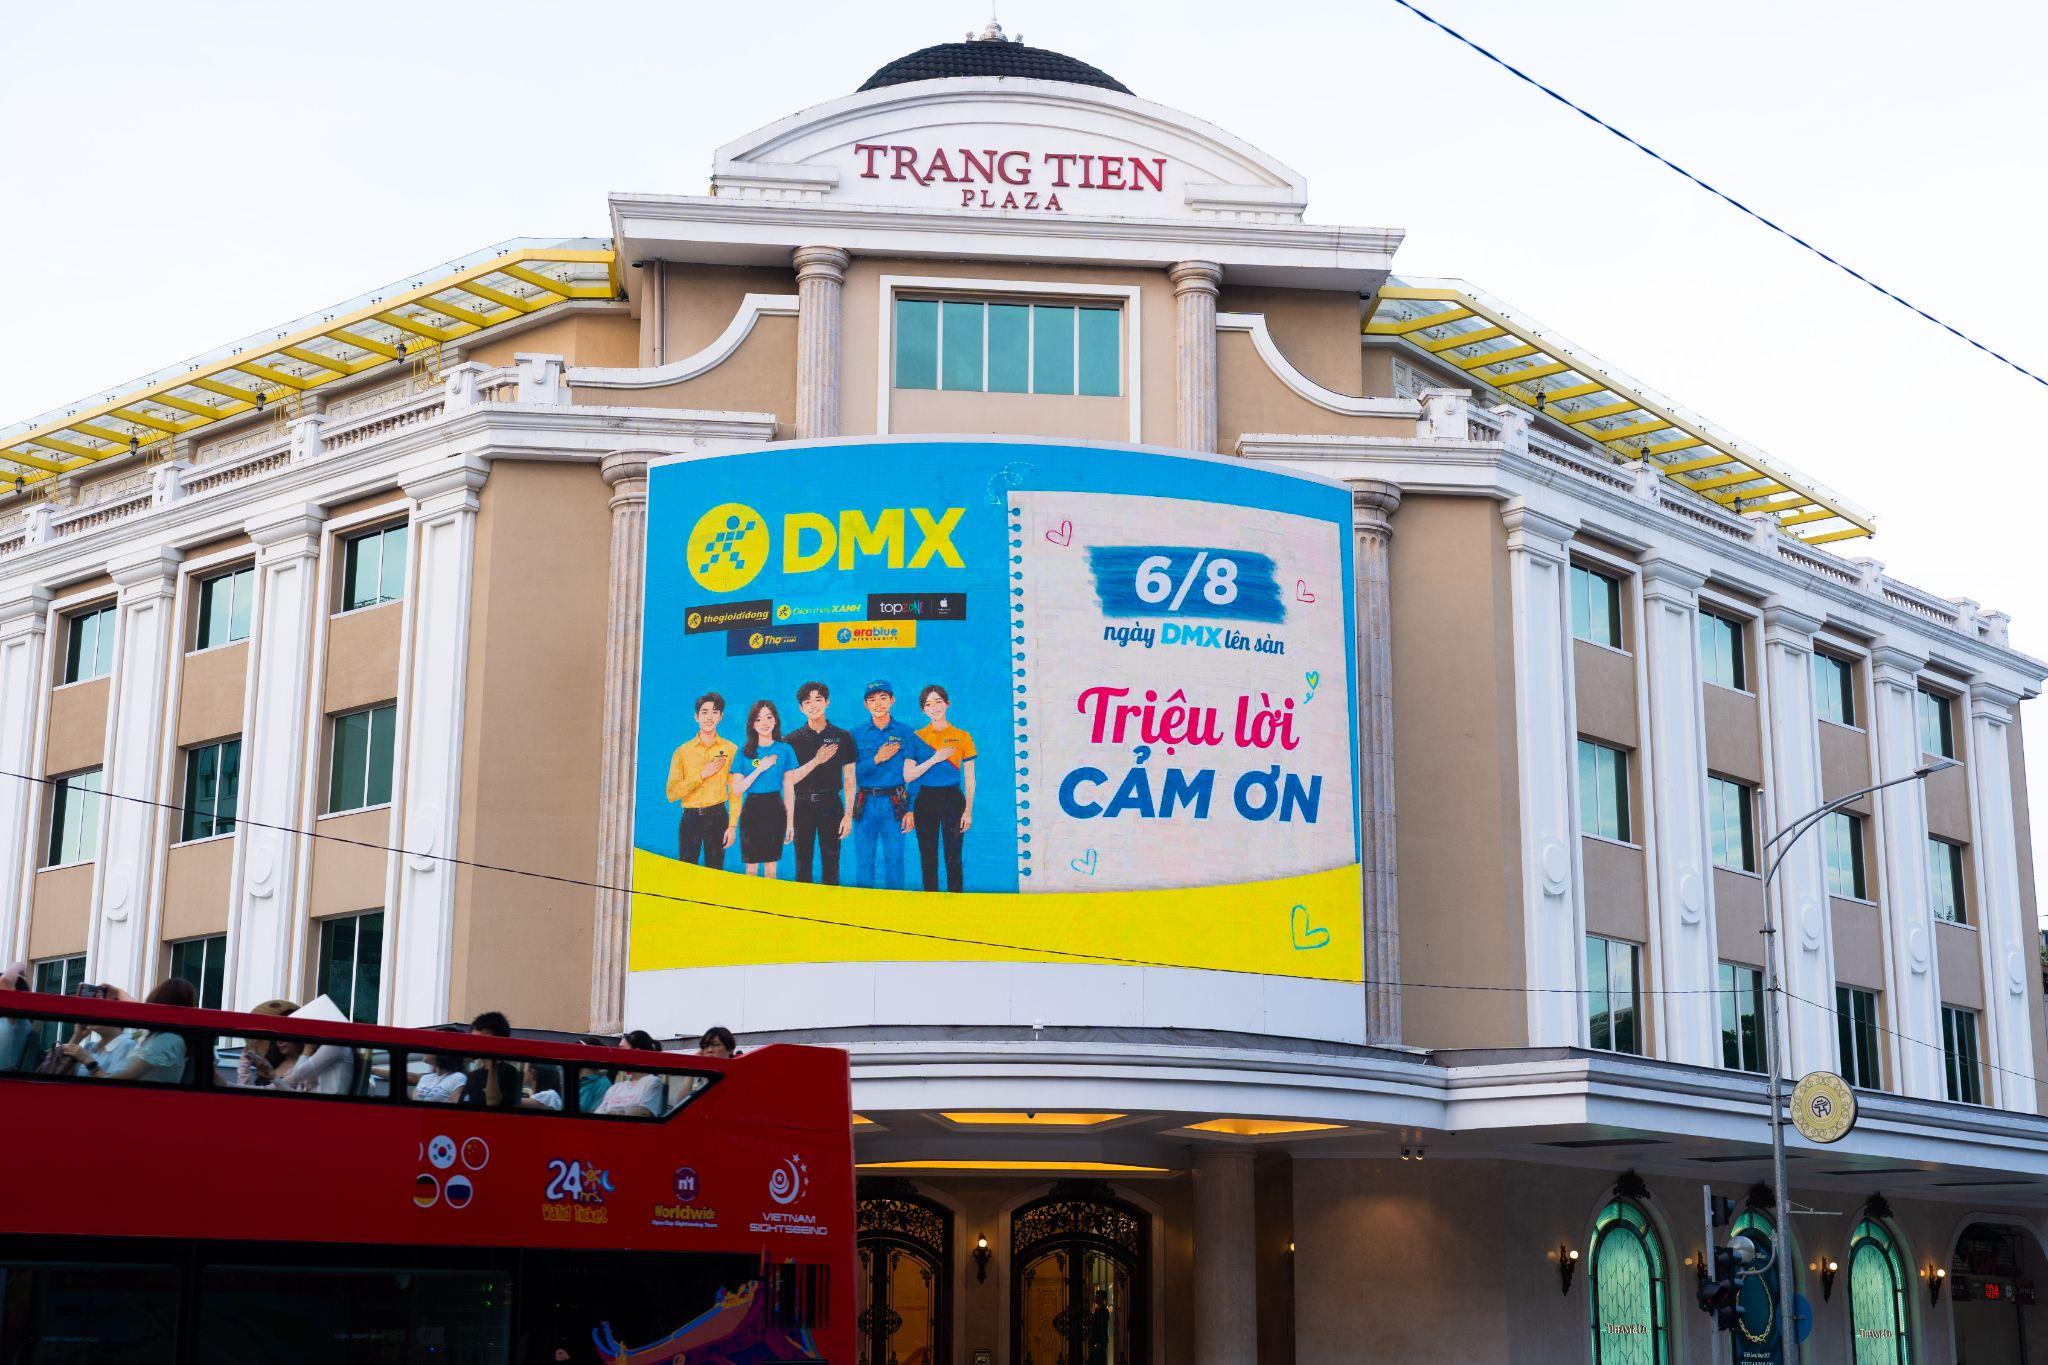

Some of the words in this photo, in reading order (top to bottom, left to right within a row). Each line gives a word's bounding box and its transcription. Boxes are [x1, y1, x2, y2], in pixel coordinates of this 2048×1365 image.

[854, 143, 1032, 186] TRANG
[1044, 152, 1167, 192] TIEN
[961, 189, 1063, 211] PLAZA
[783, 507, 967, 574] DMX
[1135, 552, 1238, 612] 6/8
[853, 627, 898, 637] erablue
[1103, 622, 1156, 649] ngày
[1160, 623, 1223, 649] DMX
[1224, 629, 1250, 651] lên
[1254, 632, 1285, 655] sàn
[1077, 686, 1224, 755] Triệu
[1235, 692, 1300, 751] lời
[1058, 745, 1215, 819] CẢM
[1233, 764, 1322, 824] ƠN
[545, 1159, 582, 1200] 24
[542, 1204, 572, 1222] Valid
[574, 1205, 609, 1224] Ticket
[654, 1204, 717, 1220] Worldwide
[762, 1211, 817, 1224] VIETNAM
[749, 1223, 828, 1236] SIGHTSEEING
